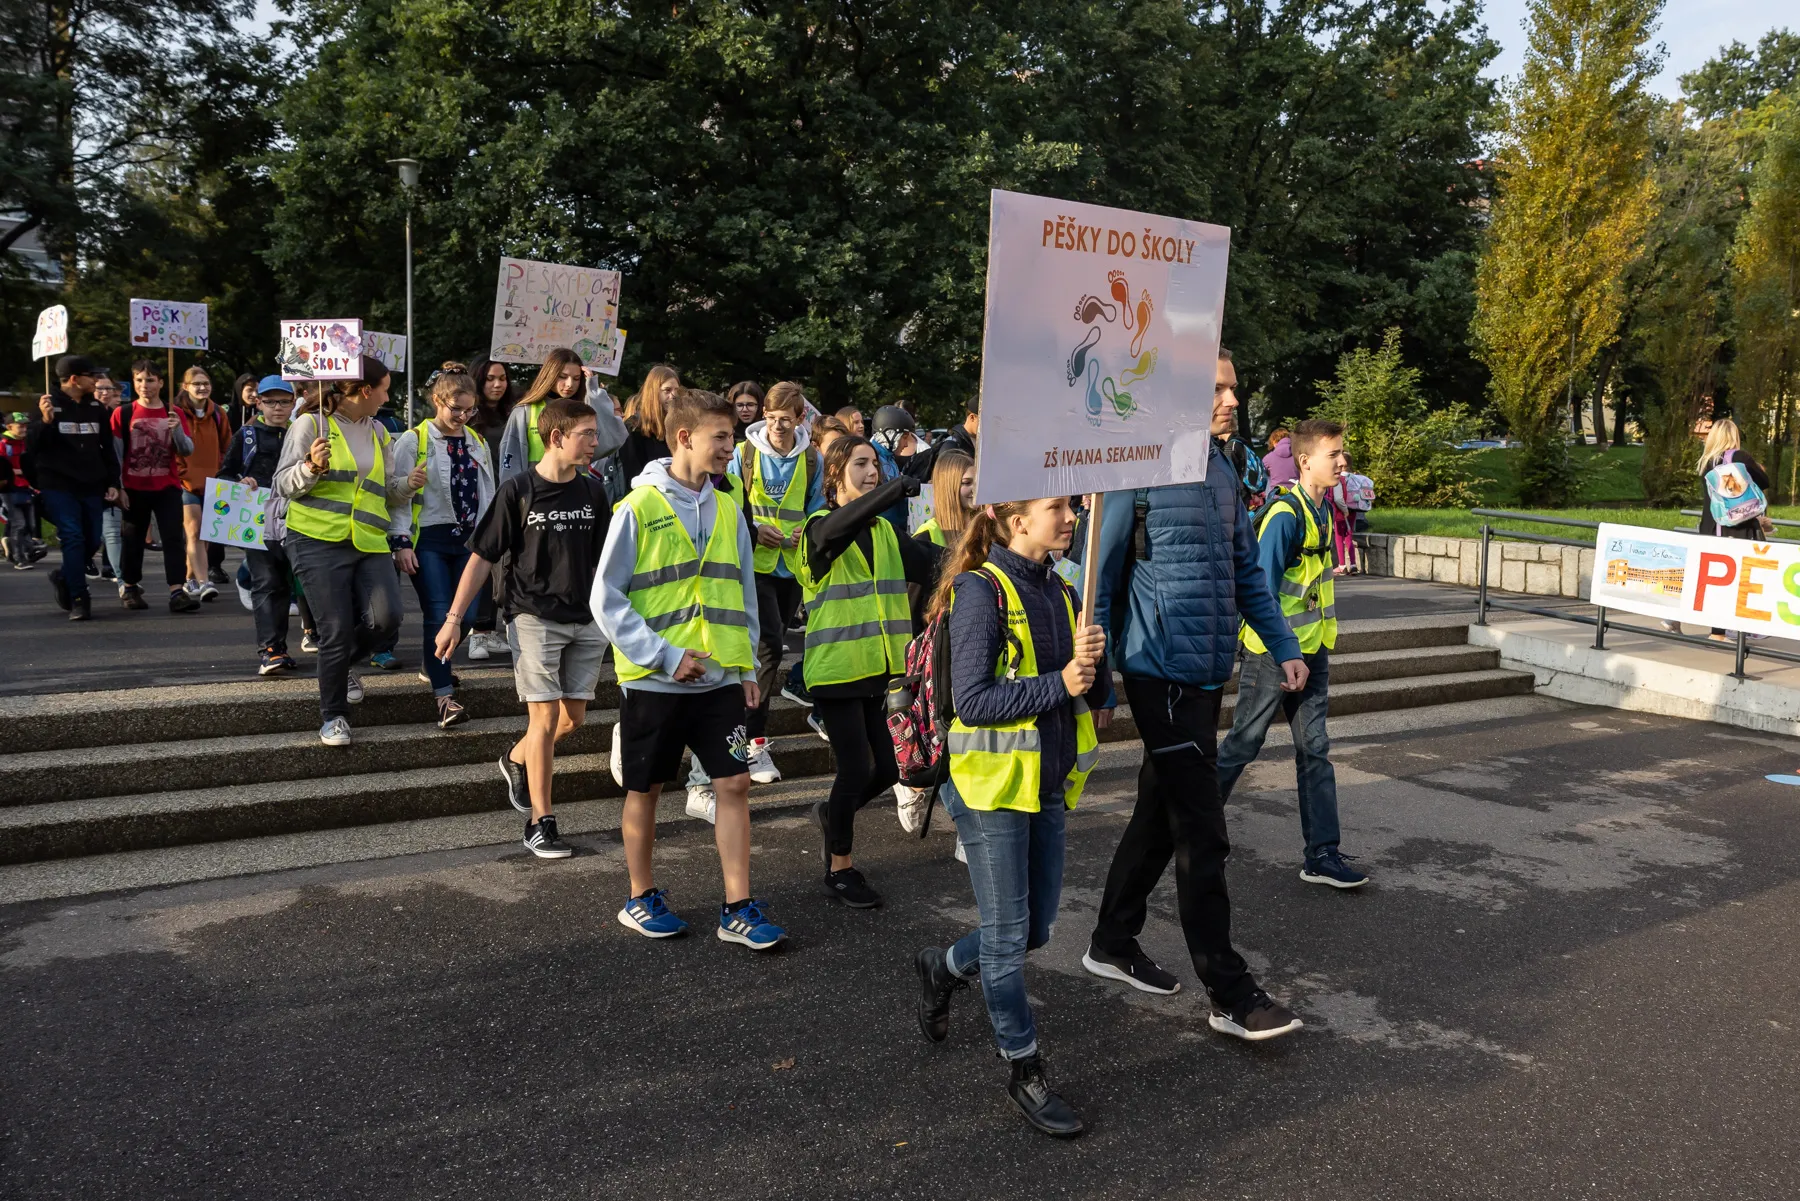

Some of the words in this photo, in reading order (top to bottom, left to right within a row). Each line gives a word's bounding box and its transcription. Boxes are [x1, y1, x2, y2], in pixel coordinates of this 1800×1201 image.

[1042, 215, 1101, 253] PĚŠKY
[1107, 229, 1136, 257] DO
[1141, 228, 1195, 264] ŠKOLY
[506, 262, 574, 296] PĚŠKY
[576, 272, 602, 296] DO
[150, 325, 165, 335] DO
[289, 323, 327, 339] PĚŠKY
[169, 330, 208, 347] ŠKOLY
[313, 342, 328, 352] DO
[313, 354, 349, 372] ŠKOLY
[1043, 446, 1059, 468] ZŠ
[1061, 447, 1103, 467] IVANA
[1106, 444, 1163, 463] SEKANINY
[527, 511, 547, 526] BE
[1611, 540, 1623, 552] ZŠ
